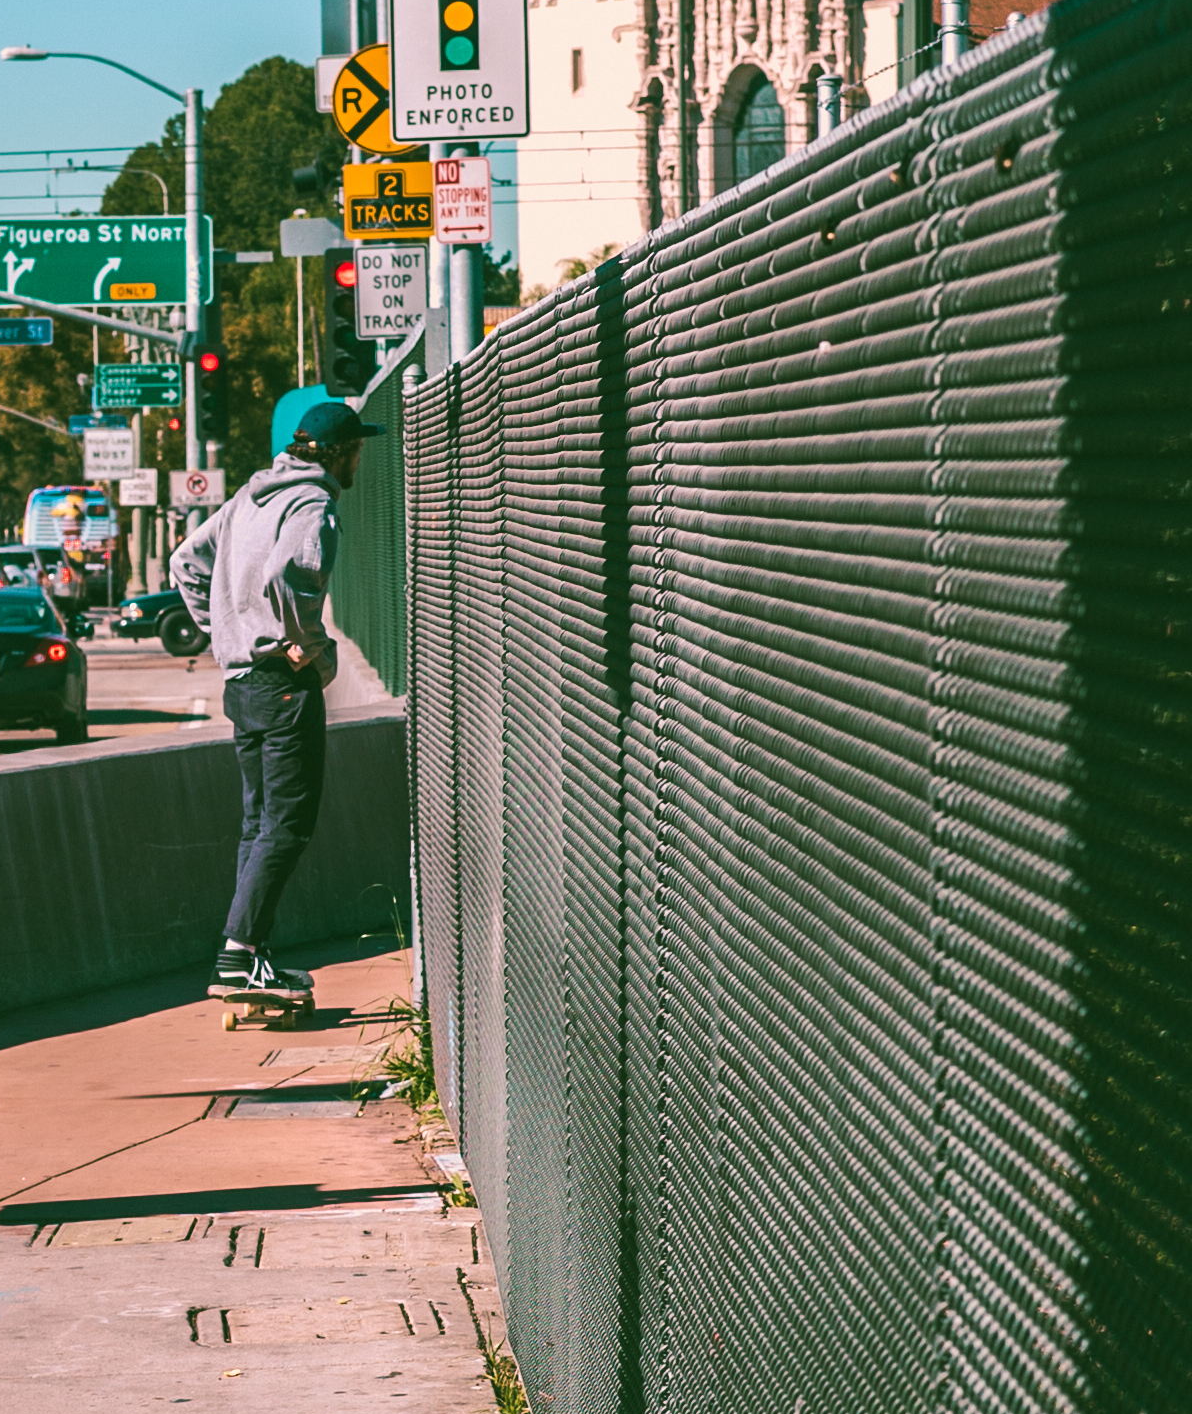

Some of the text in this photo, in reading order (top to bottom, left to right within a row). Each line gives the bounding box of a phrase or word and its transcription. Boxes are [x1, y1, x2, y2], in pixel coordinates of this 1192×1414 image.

[342, 87, 362, 113] R
[427, 83, 493, 101] PHOTO
[407, 106, 514, 125] ENFORCED
[438, 162, 458, 182] NO
[383, 175, 398, 196] 2
[439, 187, 487, 204] STOPPING
[354, 203, 429, 223] TRACKS
[440, 206, 486, 218] ANY TIME
[97, 224, 122, 242] St
[362, 254, 421, 269] DO NOT
[373, 274, 412, 289] STOP
[117, 286, 150, 297] ONLY
[382, 295, 404, 309] ON
[27, 325, 43, 338] St
[93, 450, 126, 458] MUST
